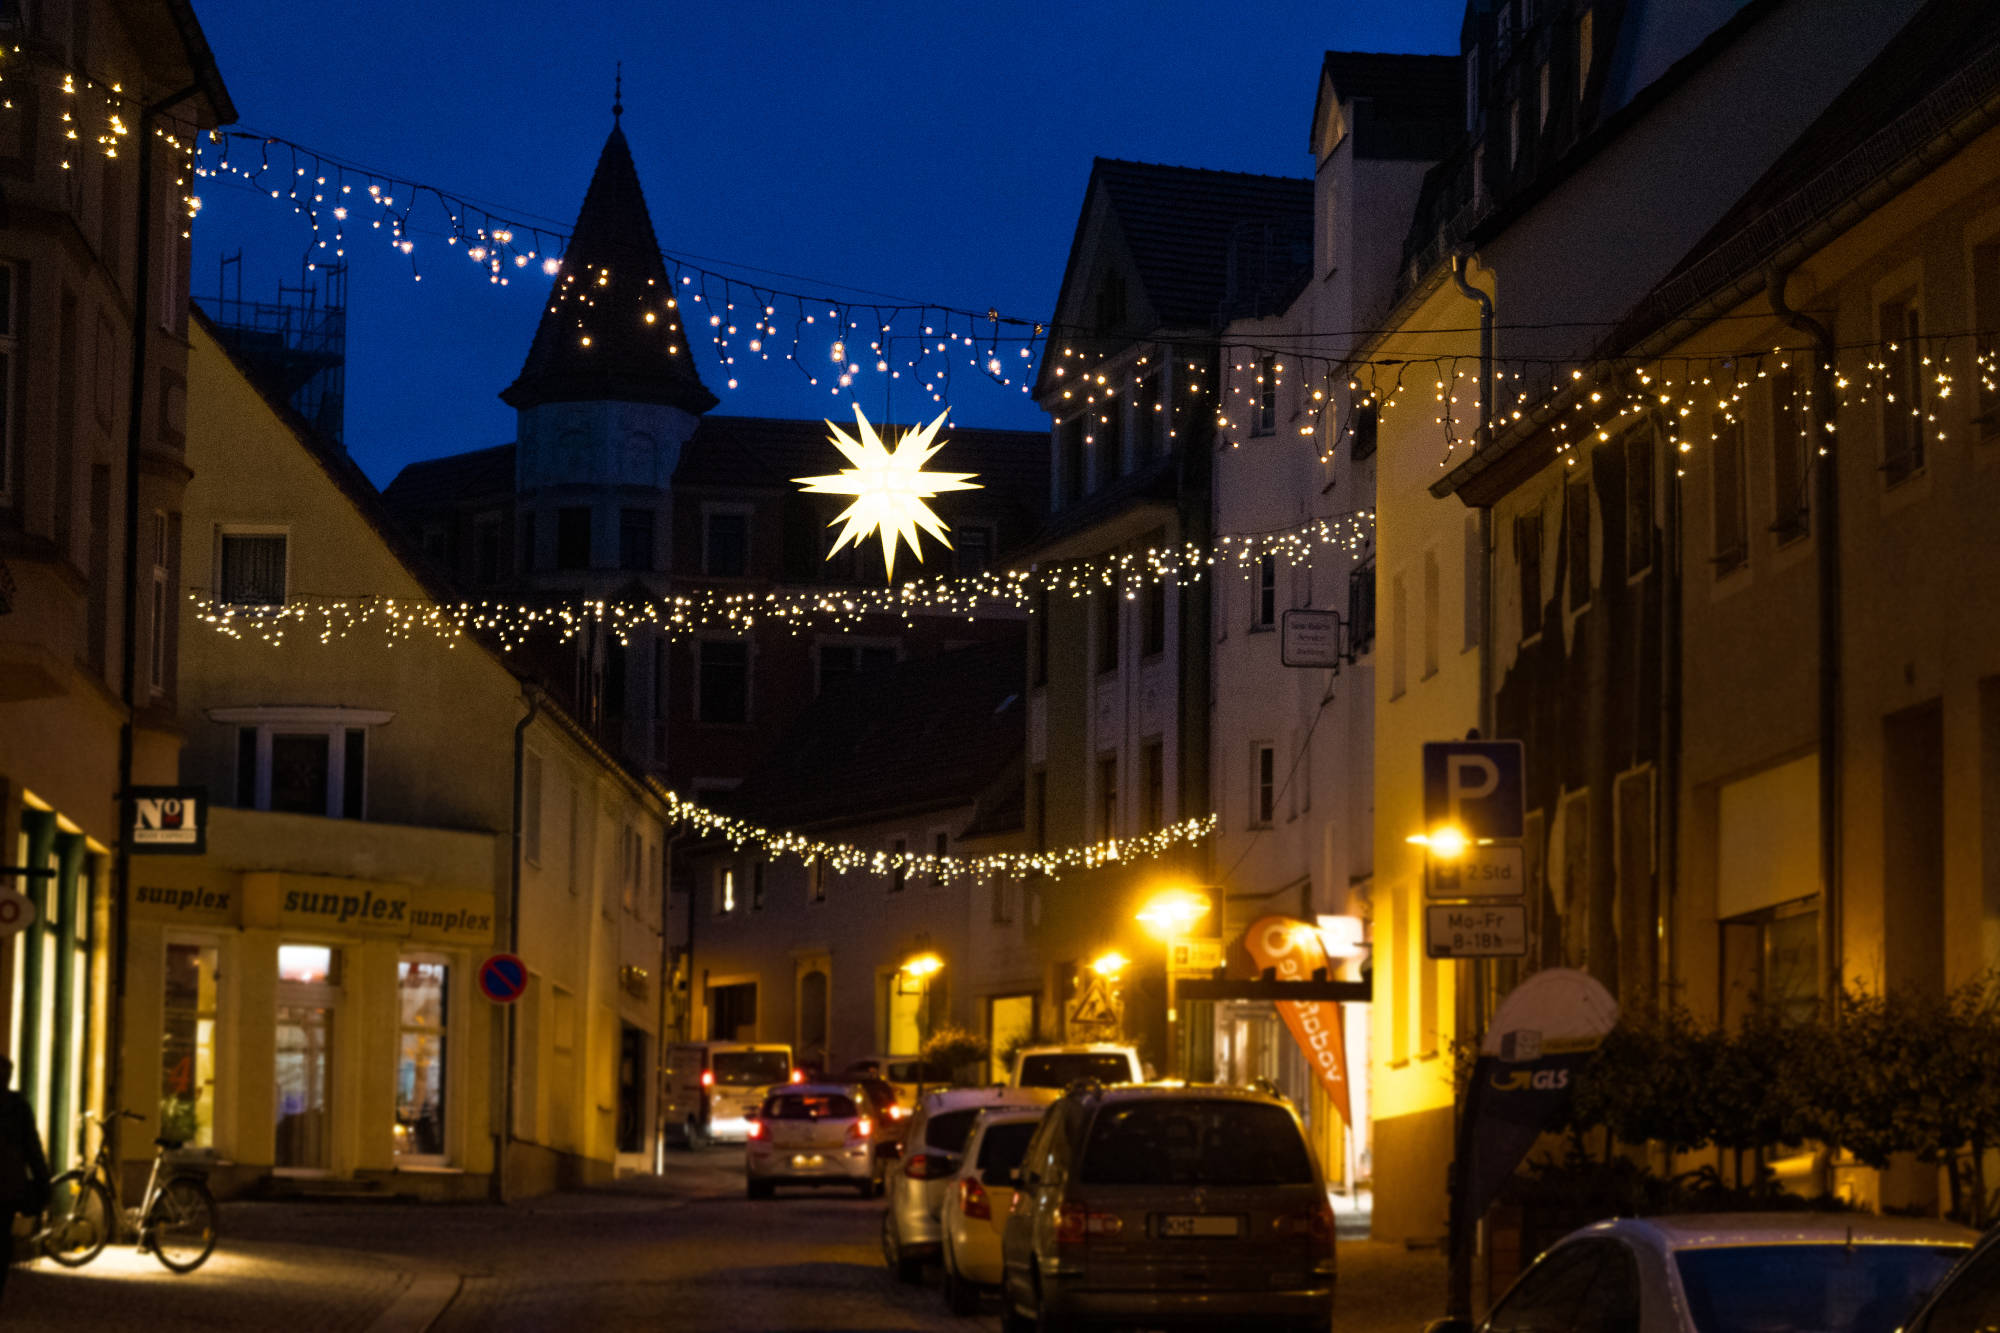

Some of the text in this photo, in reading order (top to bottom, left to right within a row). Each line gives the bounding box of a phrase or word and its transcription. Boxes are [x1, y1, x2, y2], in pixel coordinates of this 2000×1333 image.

[1446, 753, 1500, 822] P
[136, 885, 231, 910] sunplex
[284, 889, 407, 923] sunplex
[1448, 912, 1504, 930] Mo-Fr
[1531, 1068, 1569, 1091] GLS
